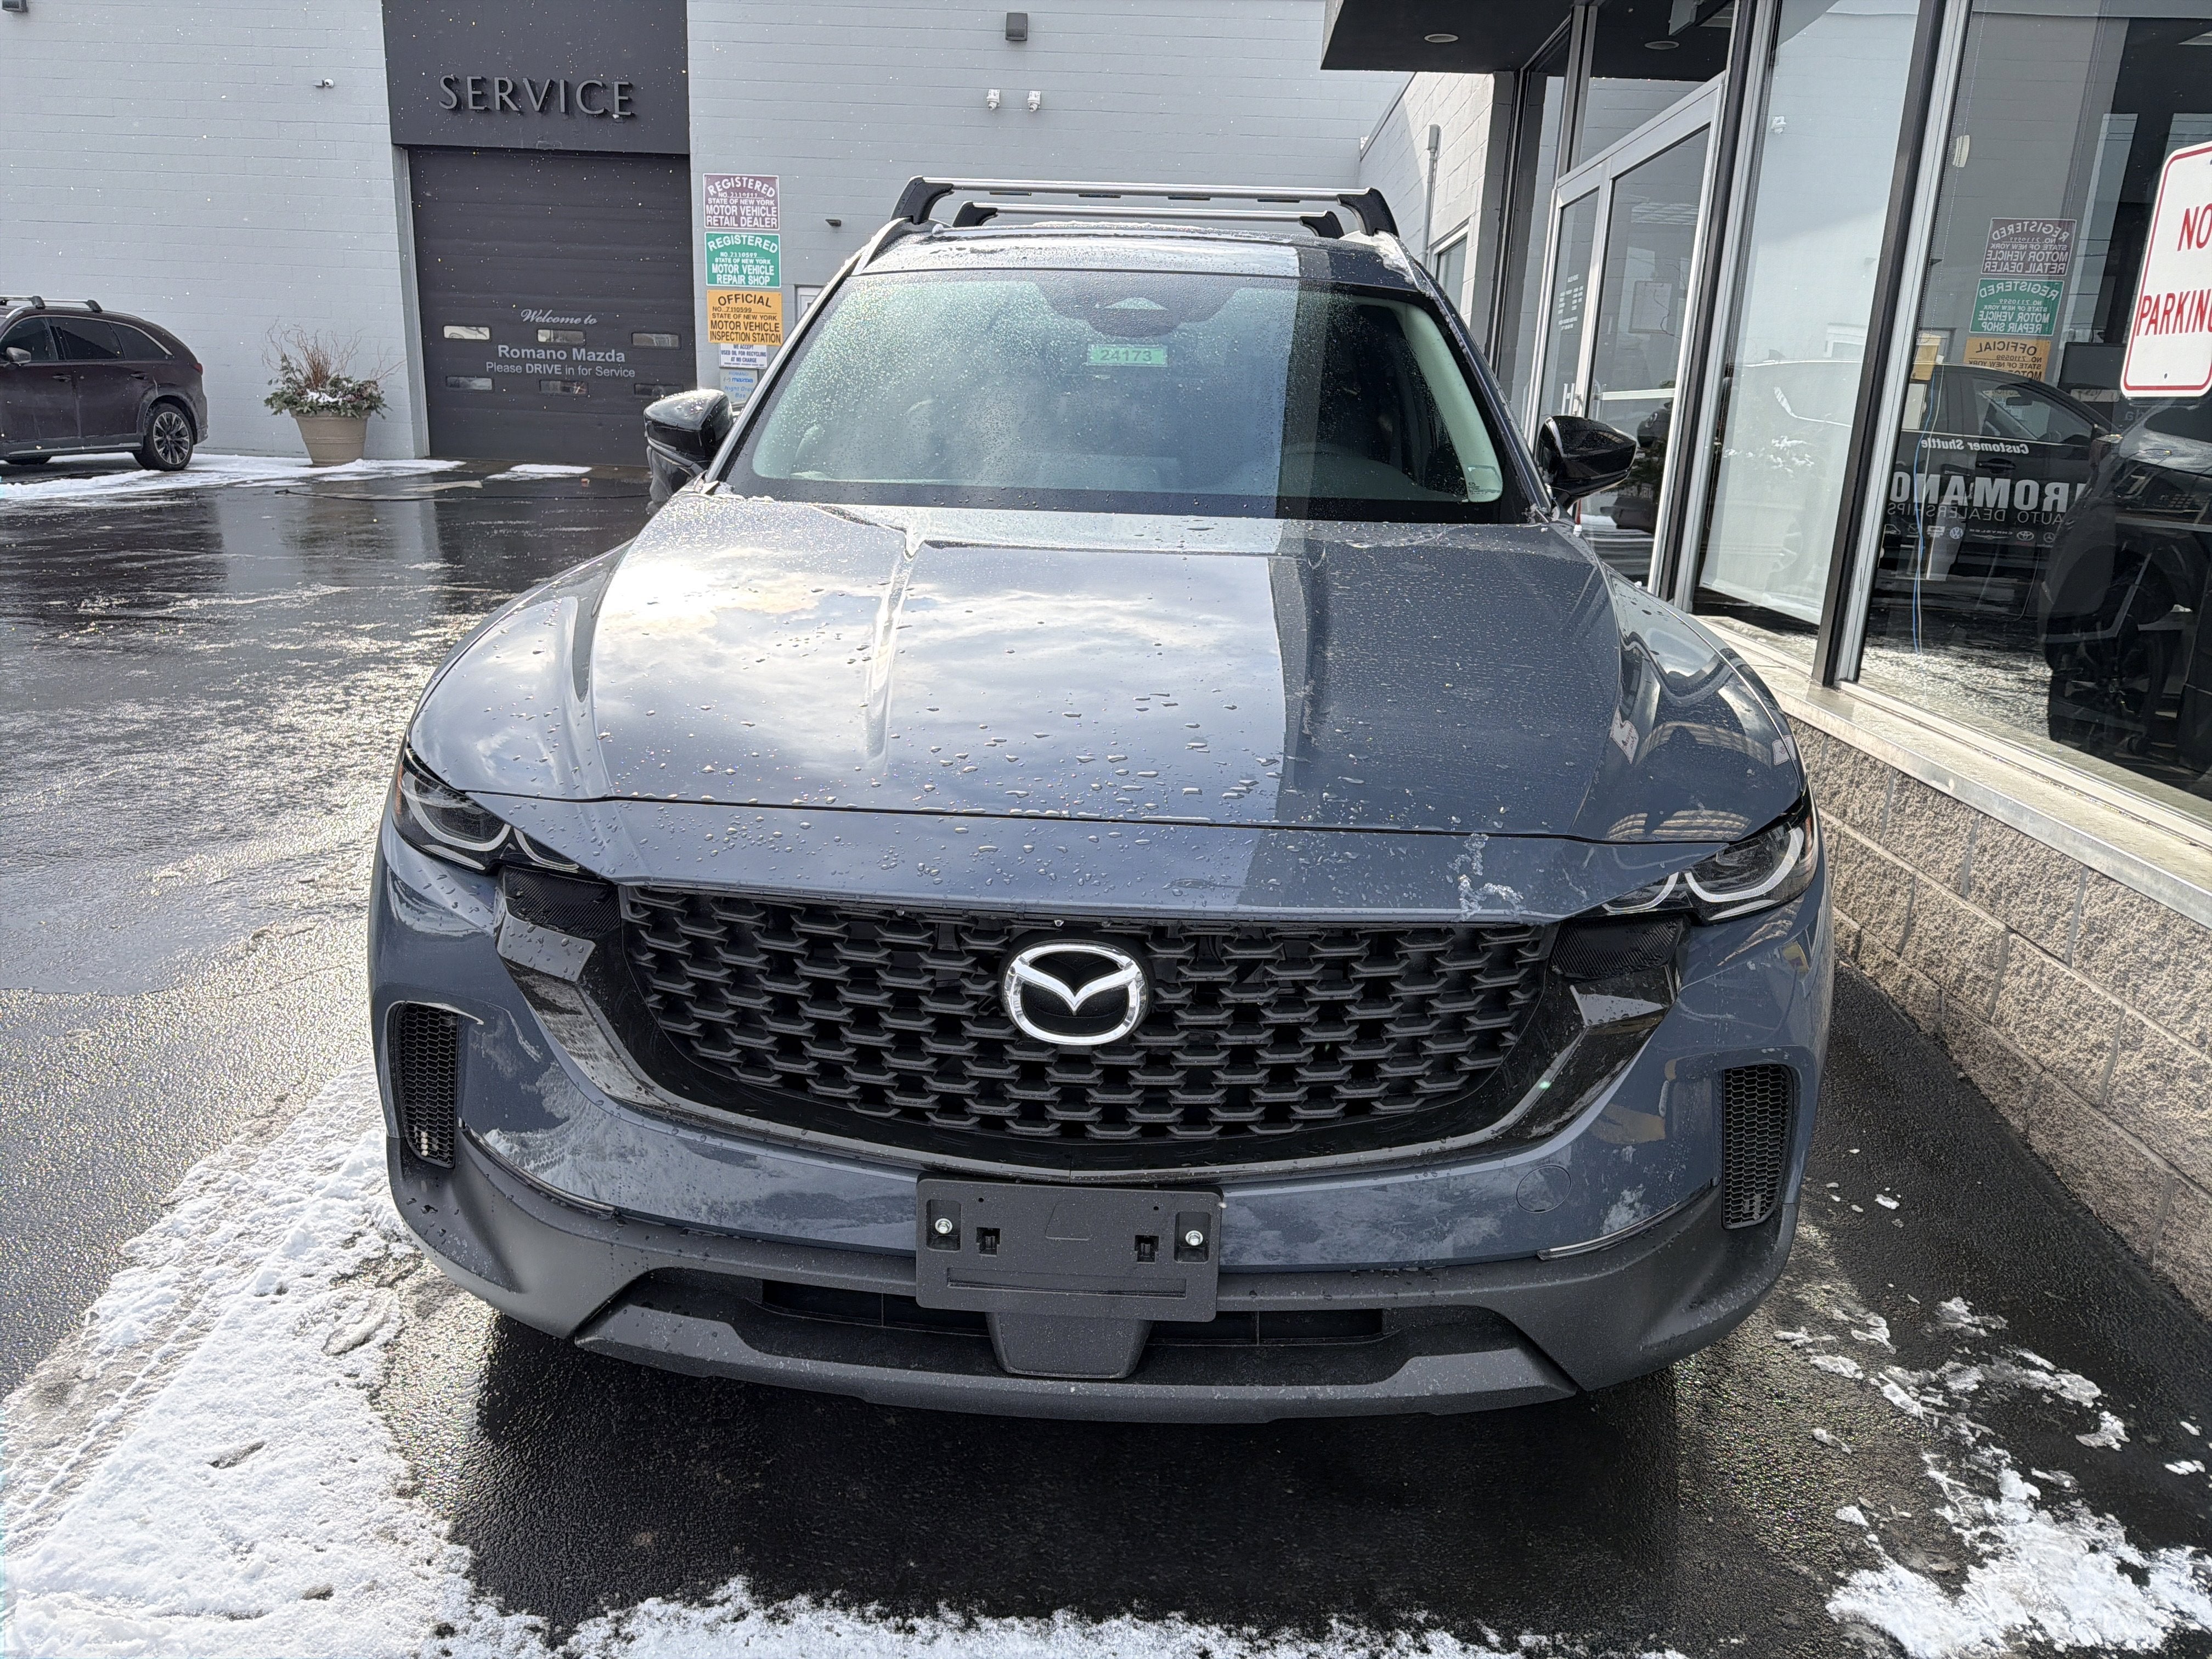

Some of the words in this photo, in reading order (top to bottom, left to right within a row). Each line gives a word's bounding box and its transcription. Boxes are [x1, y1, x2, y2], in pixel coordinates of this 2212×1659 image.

[438, 75, 632, 116] SERVICE
[707, 177, 775, 198] REGISTERED
[706, 205, 737, 216] MOTOR
[740, 206, 777, 217] VEHICLE
[706, 216, 738, 227] RETAIL
[741, 217, 777, 228] DEALER
[2177, 203, 2212, 252] NO
[708, 235, 778, 253] REGISTERED
[712, 263, 739, 274] MOTOR
[742, 265, 774, 275] VEHICLE
[716, 274, 746, 285] REPAIR
[748, 275, 770, 285] SHOP
[718, 294, 772, 308] OFFICIAL
[521, 309, 582, 324] Welcome
[583, 314, 598, 325] to
[2136, 289, 2212, 336] PARKIN
[710, 320, 741, 331] MOTOR
[743, 321, 780, 332] VEHICLE
[710, 331, 751, 342] INSPECTION
[752, 332, 781, 343] STATION
[498, 345, 567, 360] Romano
[572, 347, 625, 363] Mazda
[1099, 349, 1152, 362] 24173
[486, 362, 522, 373] Please
[526, 363, 562, 375] DRIVE
[565, 365, 575, 375] in
[578, 365, 592, 376] for
[595, 365, 635, 377] Service
